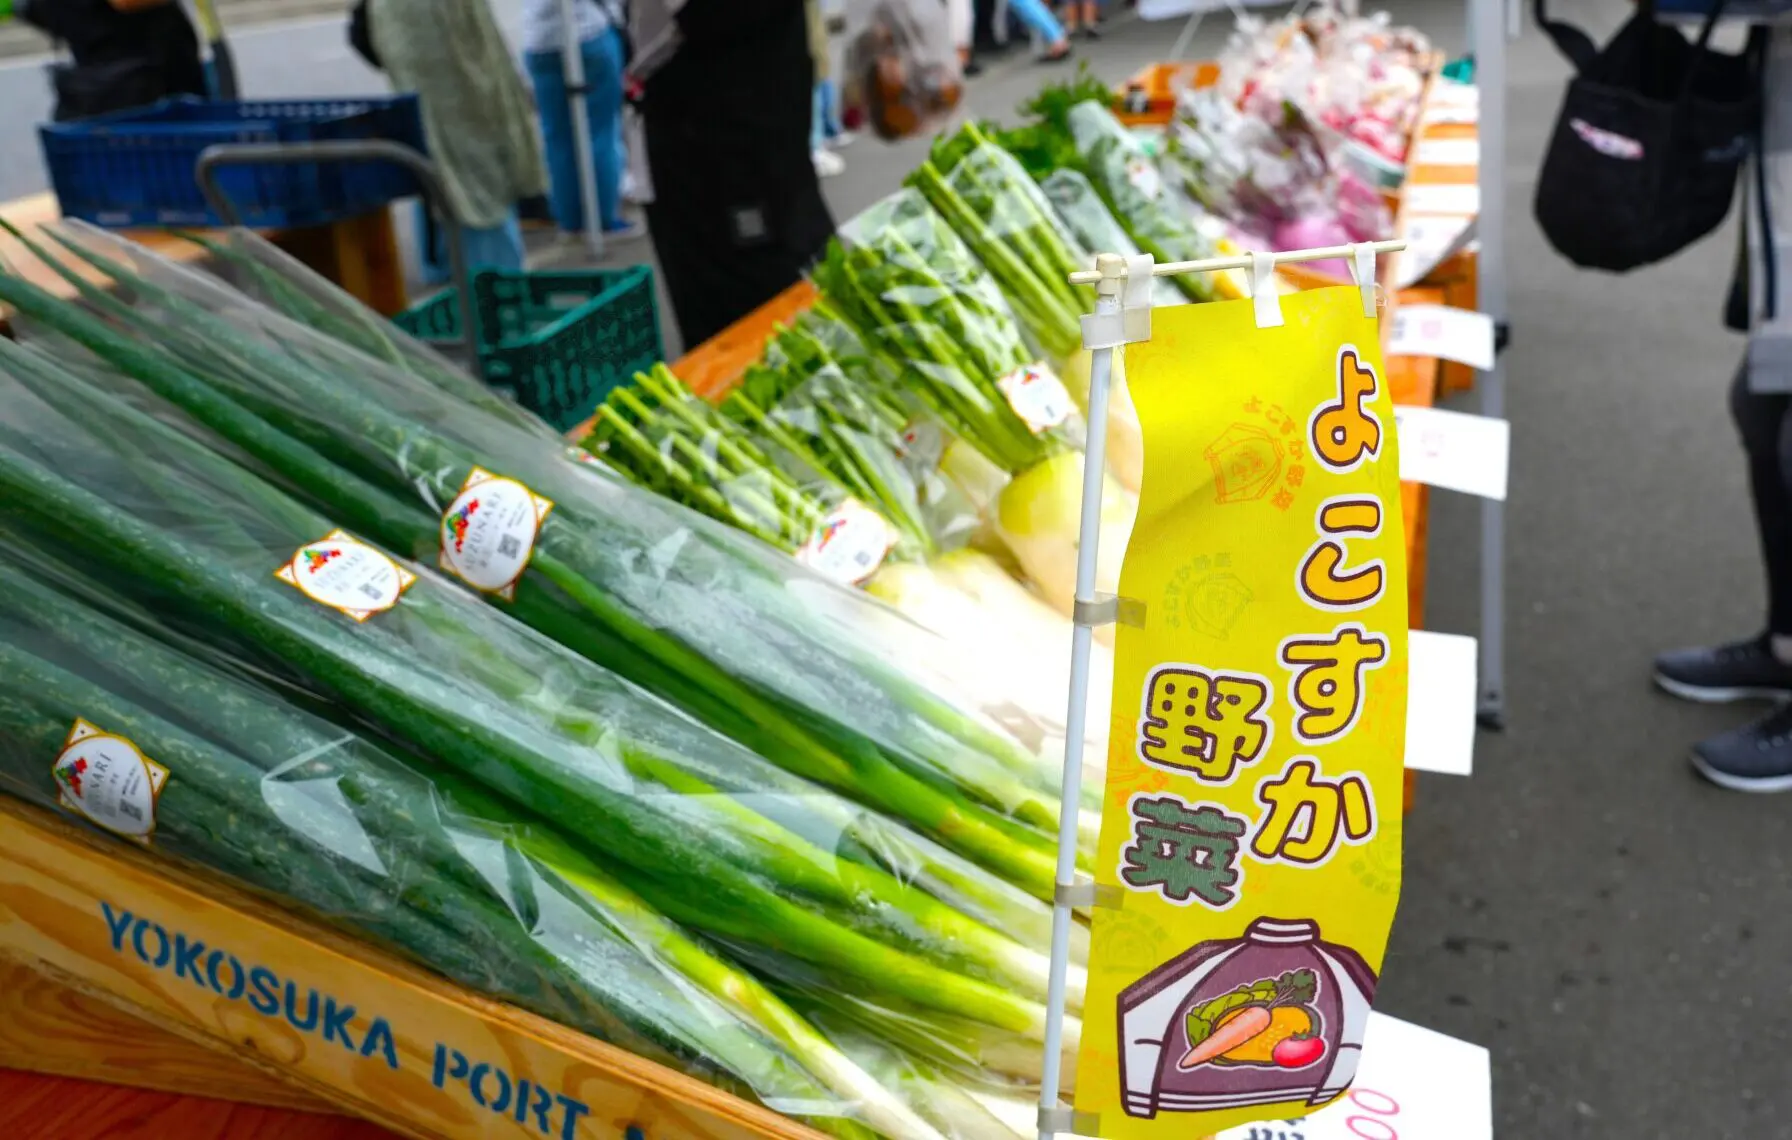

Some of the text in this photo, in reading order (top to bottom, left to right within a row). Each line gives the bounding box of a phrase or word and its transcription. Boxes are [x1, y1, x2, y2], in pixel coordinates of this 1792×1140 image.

[1250, 346, 1387, 865] よこすか
[1119, 666, 1269, 907] 野菜
[101, 901, 590, 1140] YOKOSUKA PORT
